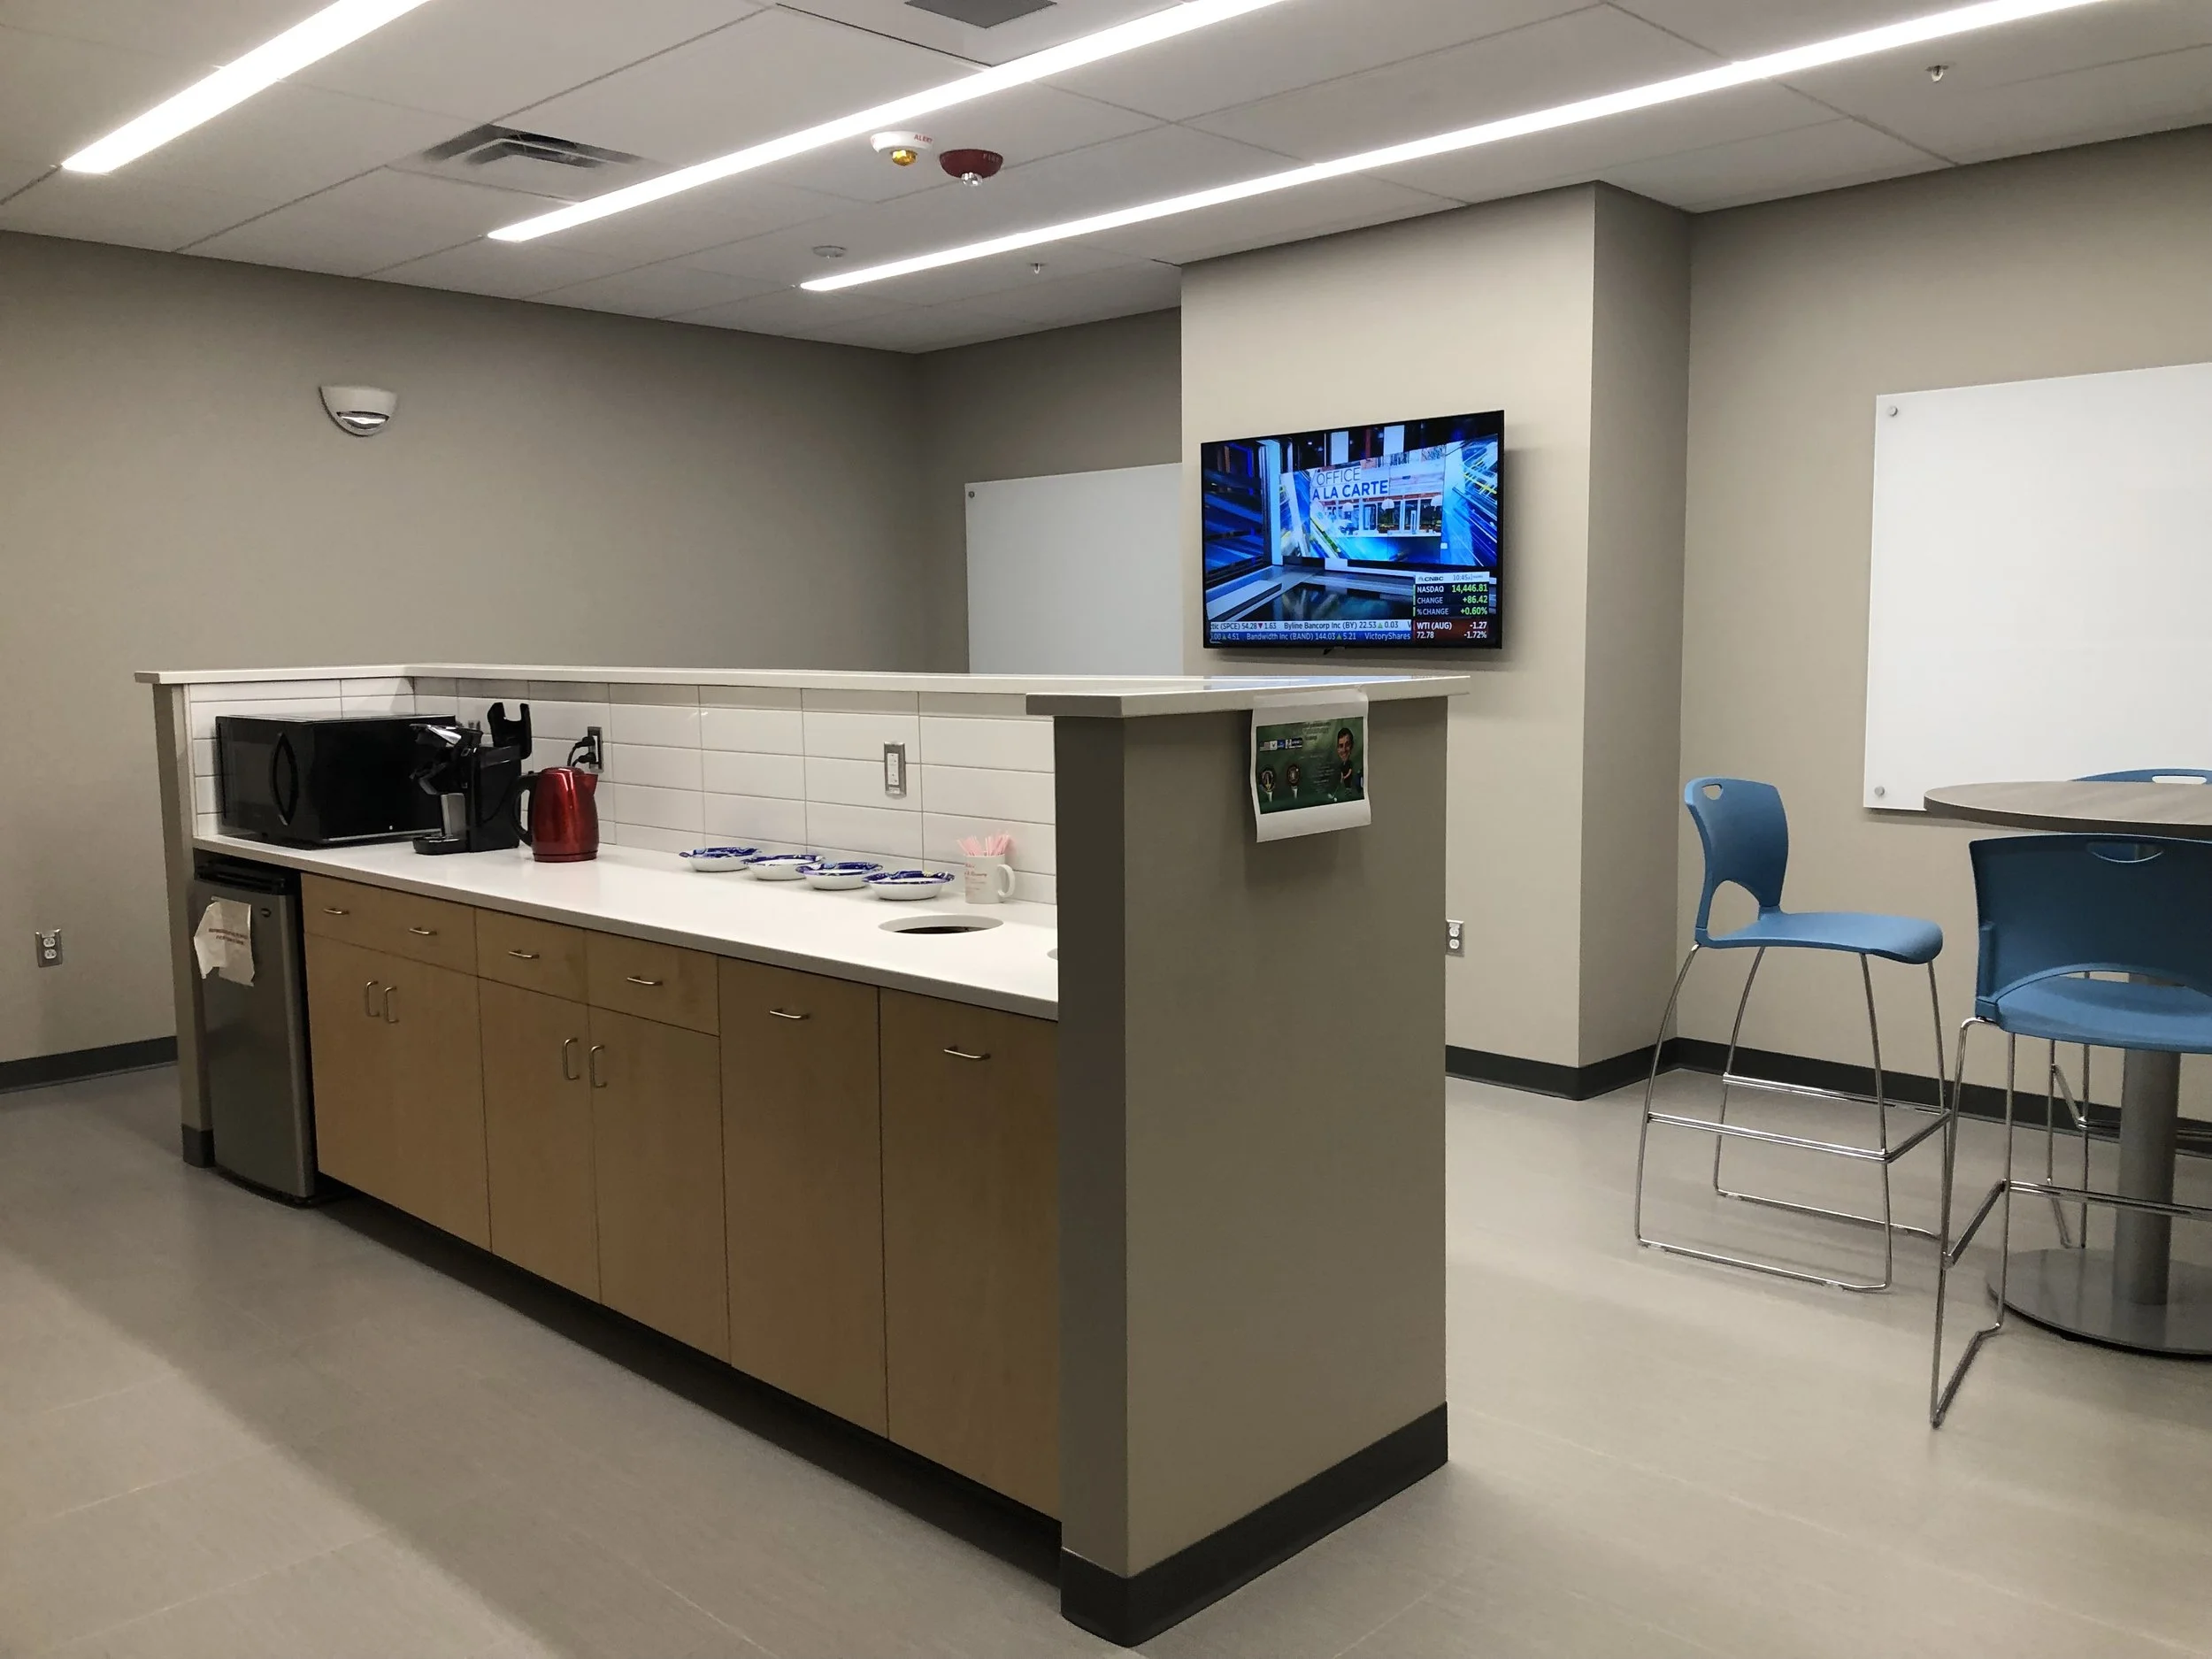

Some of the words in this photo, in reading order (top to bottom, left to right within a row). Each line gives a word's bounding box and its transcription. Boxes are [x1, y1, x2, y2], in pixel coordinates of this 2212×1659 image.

[1317, 468, 1360, 485] OFFICE
[1312, 488, 1320, 501] A
[1324, 486, 1339, 500] LA
[1342, 480, 1388, 498] CARTE
[1452, 583, 1487, 593] 14,446.81
[1220, 622, 1240, 631] (SPCE)
[1284, 622, 1302, 631] Byline
[1342, 621, 1357, 630] (BY)
[1431, 621, 1452, 630] (AUG)
